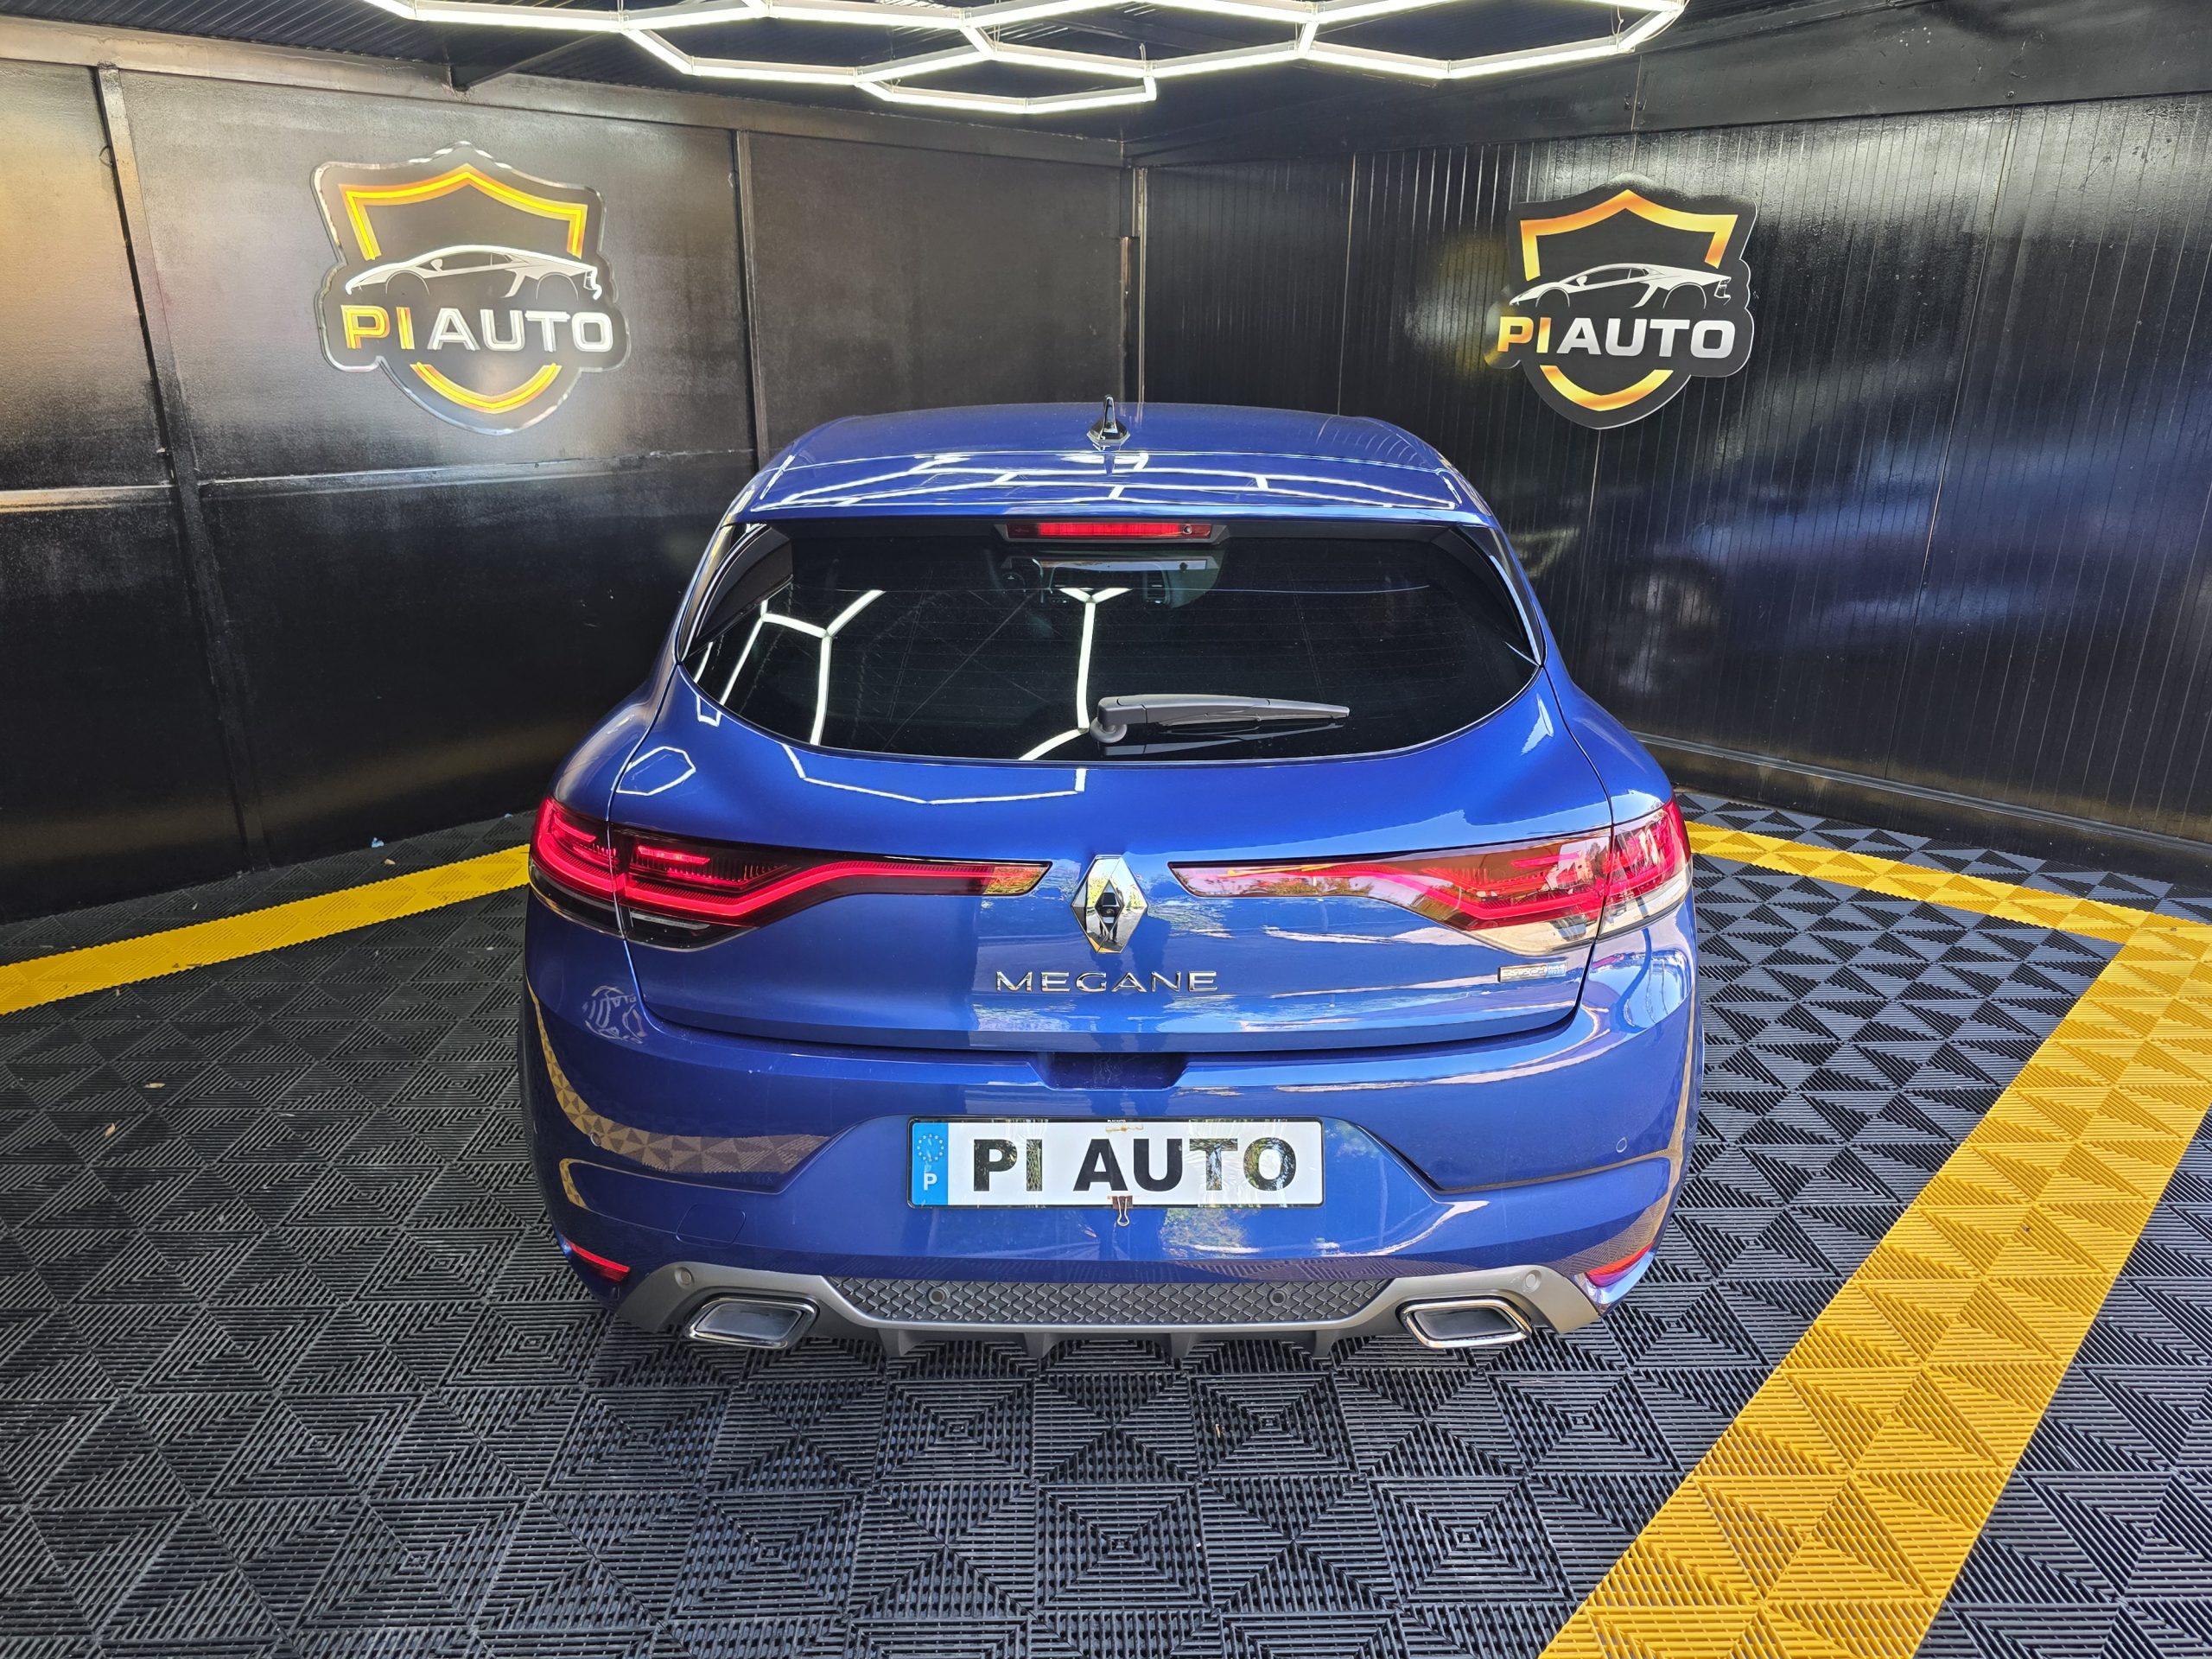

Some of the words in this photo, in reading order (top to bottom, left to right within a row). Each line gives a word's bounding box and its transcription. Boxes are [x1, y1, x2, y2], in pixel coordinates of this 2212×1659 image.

[341, 305, 415, 349] PI
[427, 308, 613, 352] AUTO
[1497, 316, 1551, 353] PI
[1556, 317, 1736, 359] AUTO
[995, 971, 1217, 992] MEGANE
[923, 1173, 938, 1191] P
[973, 1138, 1043, 1192] PI
[1072, 1137, 1297, 1192] AUTO
